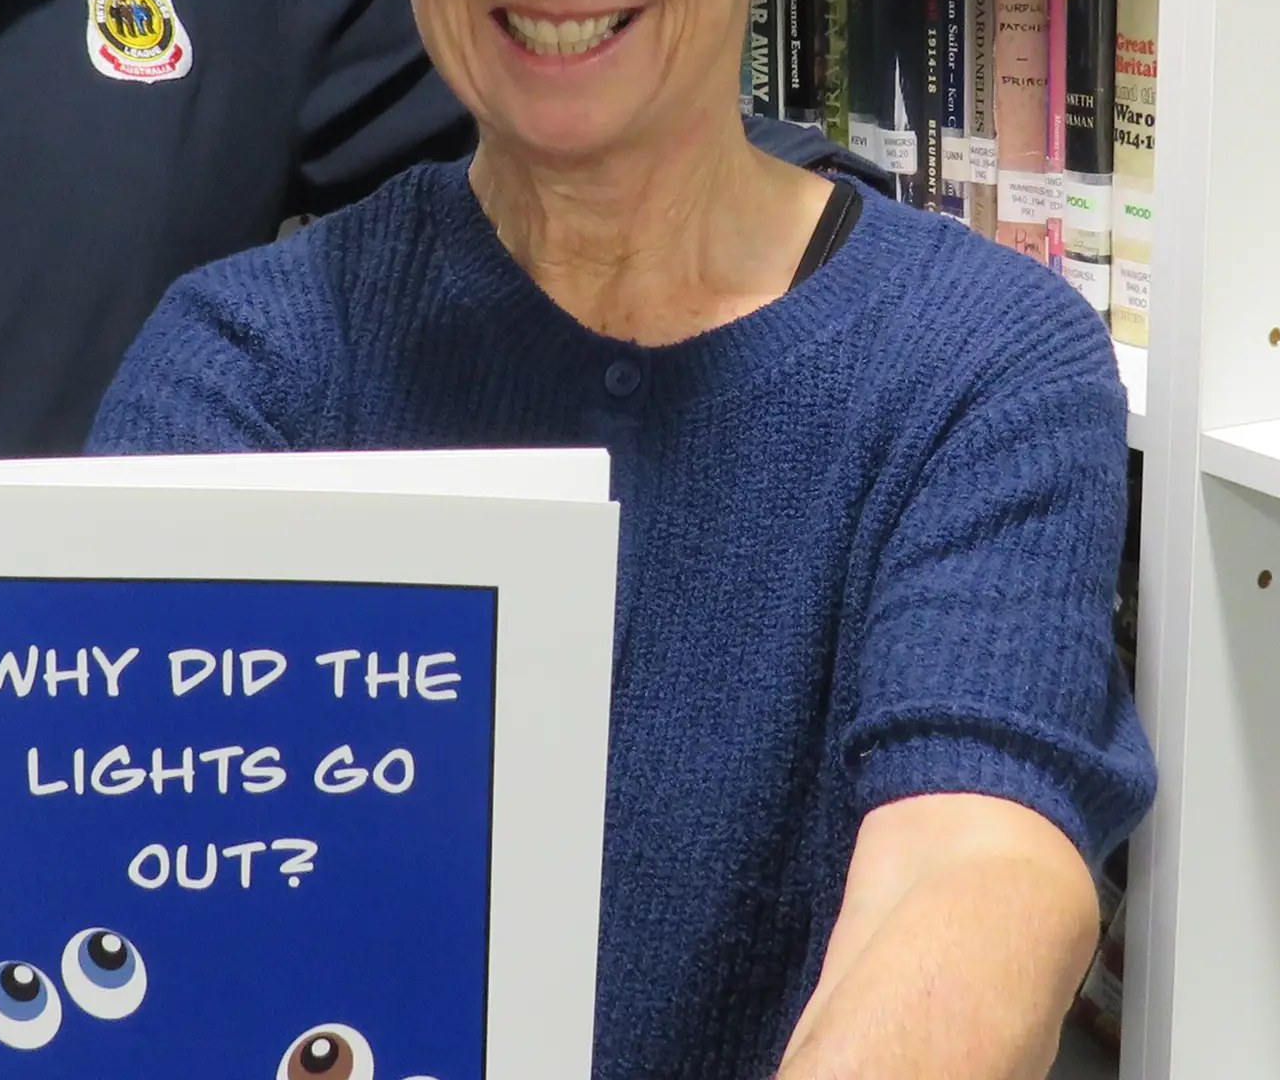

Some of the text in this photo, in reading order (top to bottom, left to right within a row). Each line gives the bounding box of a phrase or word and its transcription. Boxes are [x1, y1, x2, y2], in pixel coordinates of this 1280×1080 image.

[751, 31, 770, 103] AWAY
[790, 40, 801, 89] Everett
[927, 28, 938, 94] 1914-18
[946, 23, 958, 69] Sailor
[1115, 32, 1155, 56] Great
[947, 87, 957, 113] Ken
[1113, 103, 1143, 126] War
[927, 119, 938, 194] BEAUMONT
[1066, 195, 1090, 210] POOL
[1124, 203, 1152, 220] WOOD
[167, 648, 288, 699] DID
[315, 650, 463, 702] THE
[26, 745, 416, 797] LIGHTS GO
[126, 837, 319, 892] OUT?
